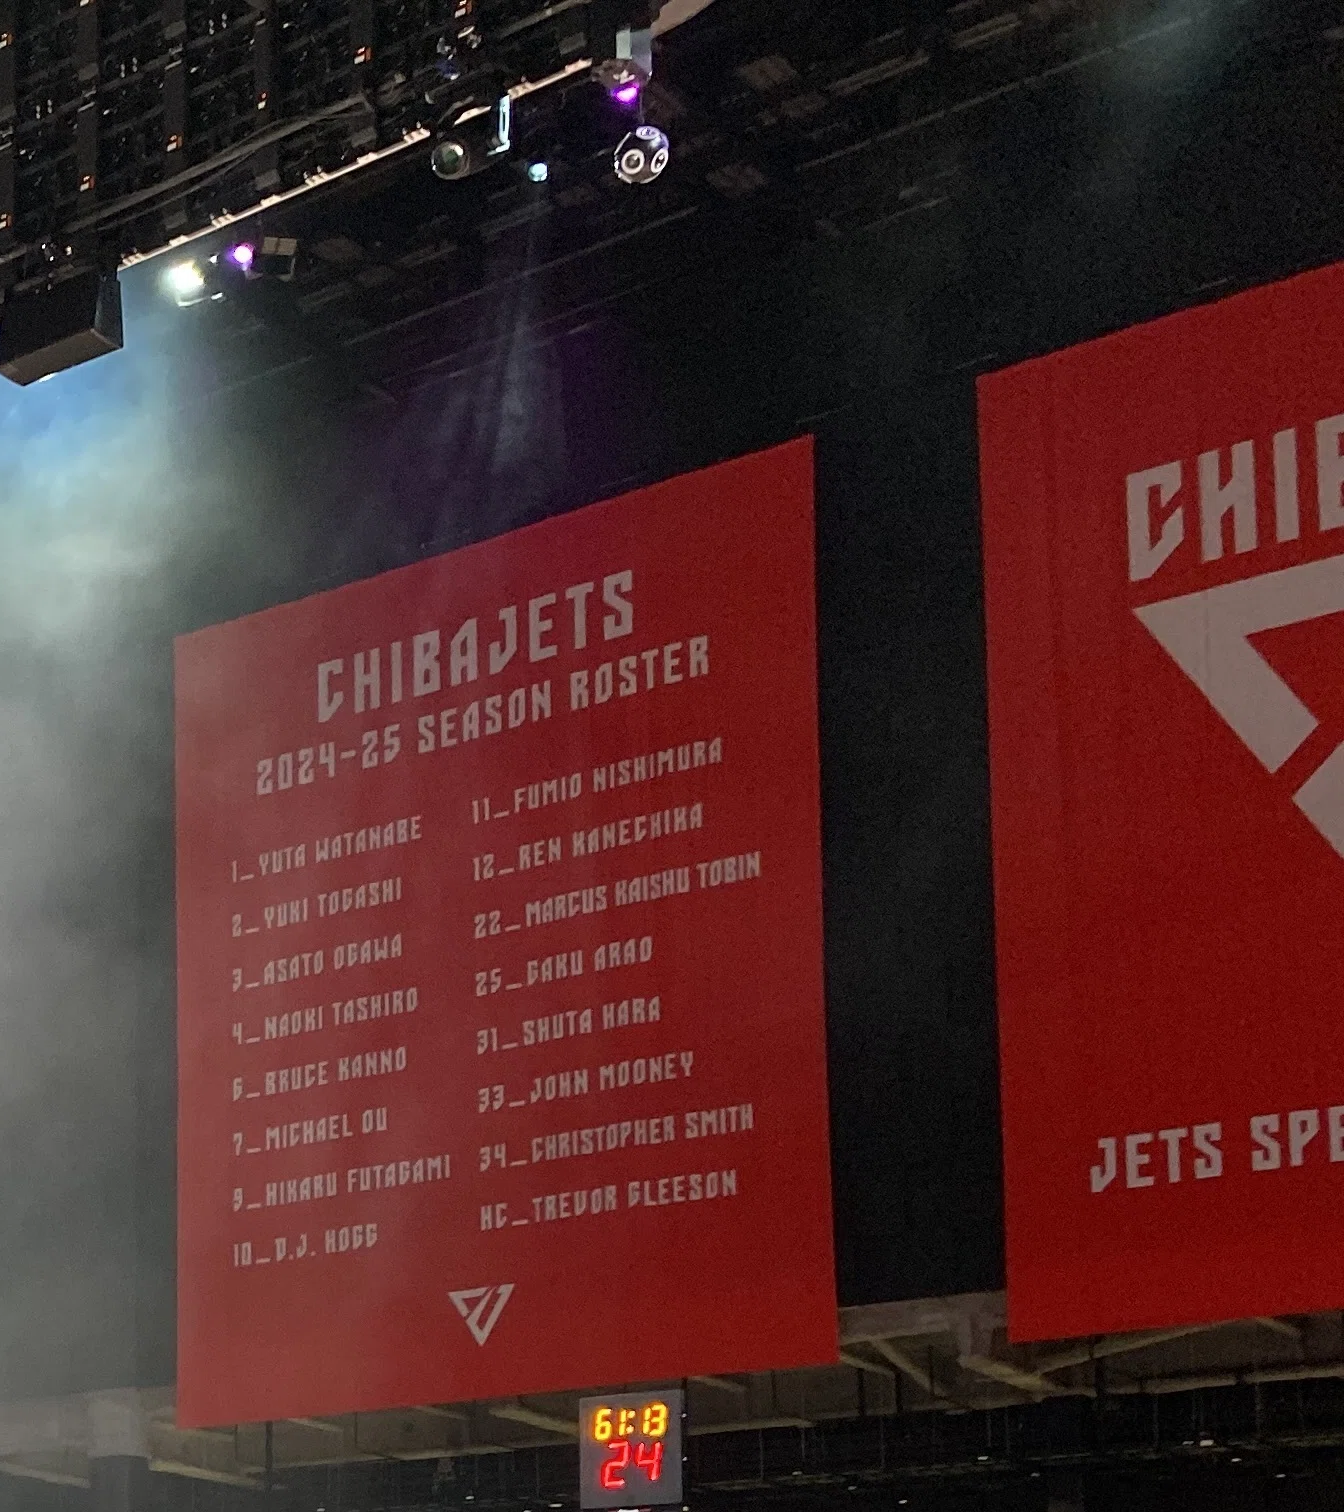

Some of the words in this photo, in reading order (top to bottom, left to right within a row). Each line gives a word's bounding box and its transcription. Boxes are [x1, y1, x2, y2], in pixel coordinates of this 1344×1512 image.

[317, 570, 634, 722] CHIBAJETS
[257, 723, 401, 795] 2024-25
[417, 680, 552, 754] SEASON
[570, 635, 709, 712] ROSTER
[593, 737, 722, 793] NISHIMURA
[315, 815, 423, 865] WATANABE
[573, 803, 703, 857] KANECHIKA
[318, 877, 401, 915] TOGASHI
[615, 862, 690, 905] KAISHU
[699, 852, 761, 888] TOBIN
[333, 934, 402, 971] OGAWA
[594, 936, 653, 972] ARAO
[331, 988, 417, 1026] TASHIRO
[602, 996, 661, 1030] HARA
[338, 1047, 407, 1082] KANNO
[599, 1051, 694, 1090] MOONEY
[362, 1108, 387, 1133] OU
[685, 1104, 753, 1137] SMITH
[347, 1155, 451, 1195] FUTAGAMI
[1090, 1122, 1223, 1193] JETS
[628, 1170, 738, 1208] GLEESON
[324, 1223, 378, 1255] HOGG
[594, 1404, 667, 1440] 61:13
[601, 1441, 663, 1488] 24
